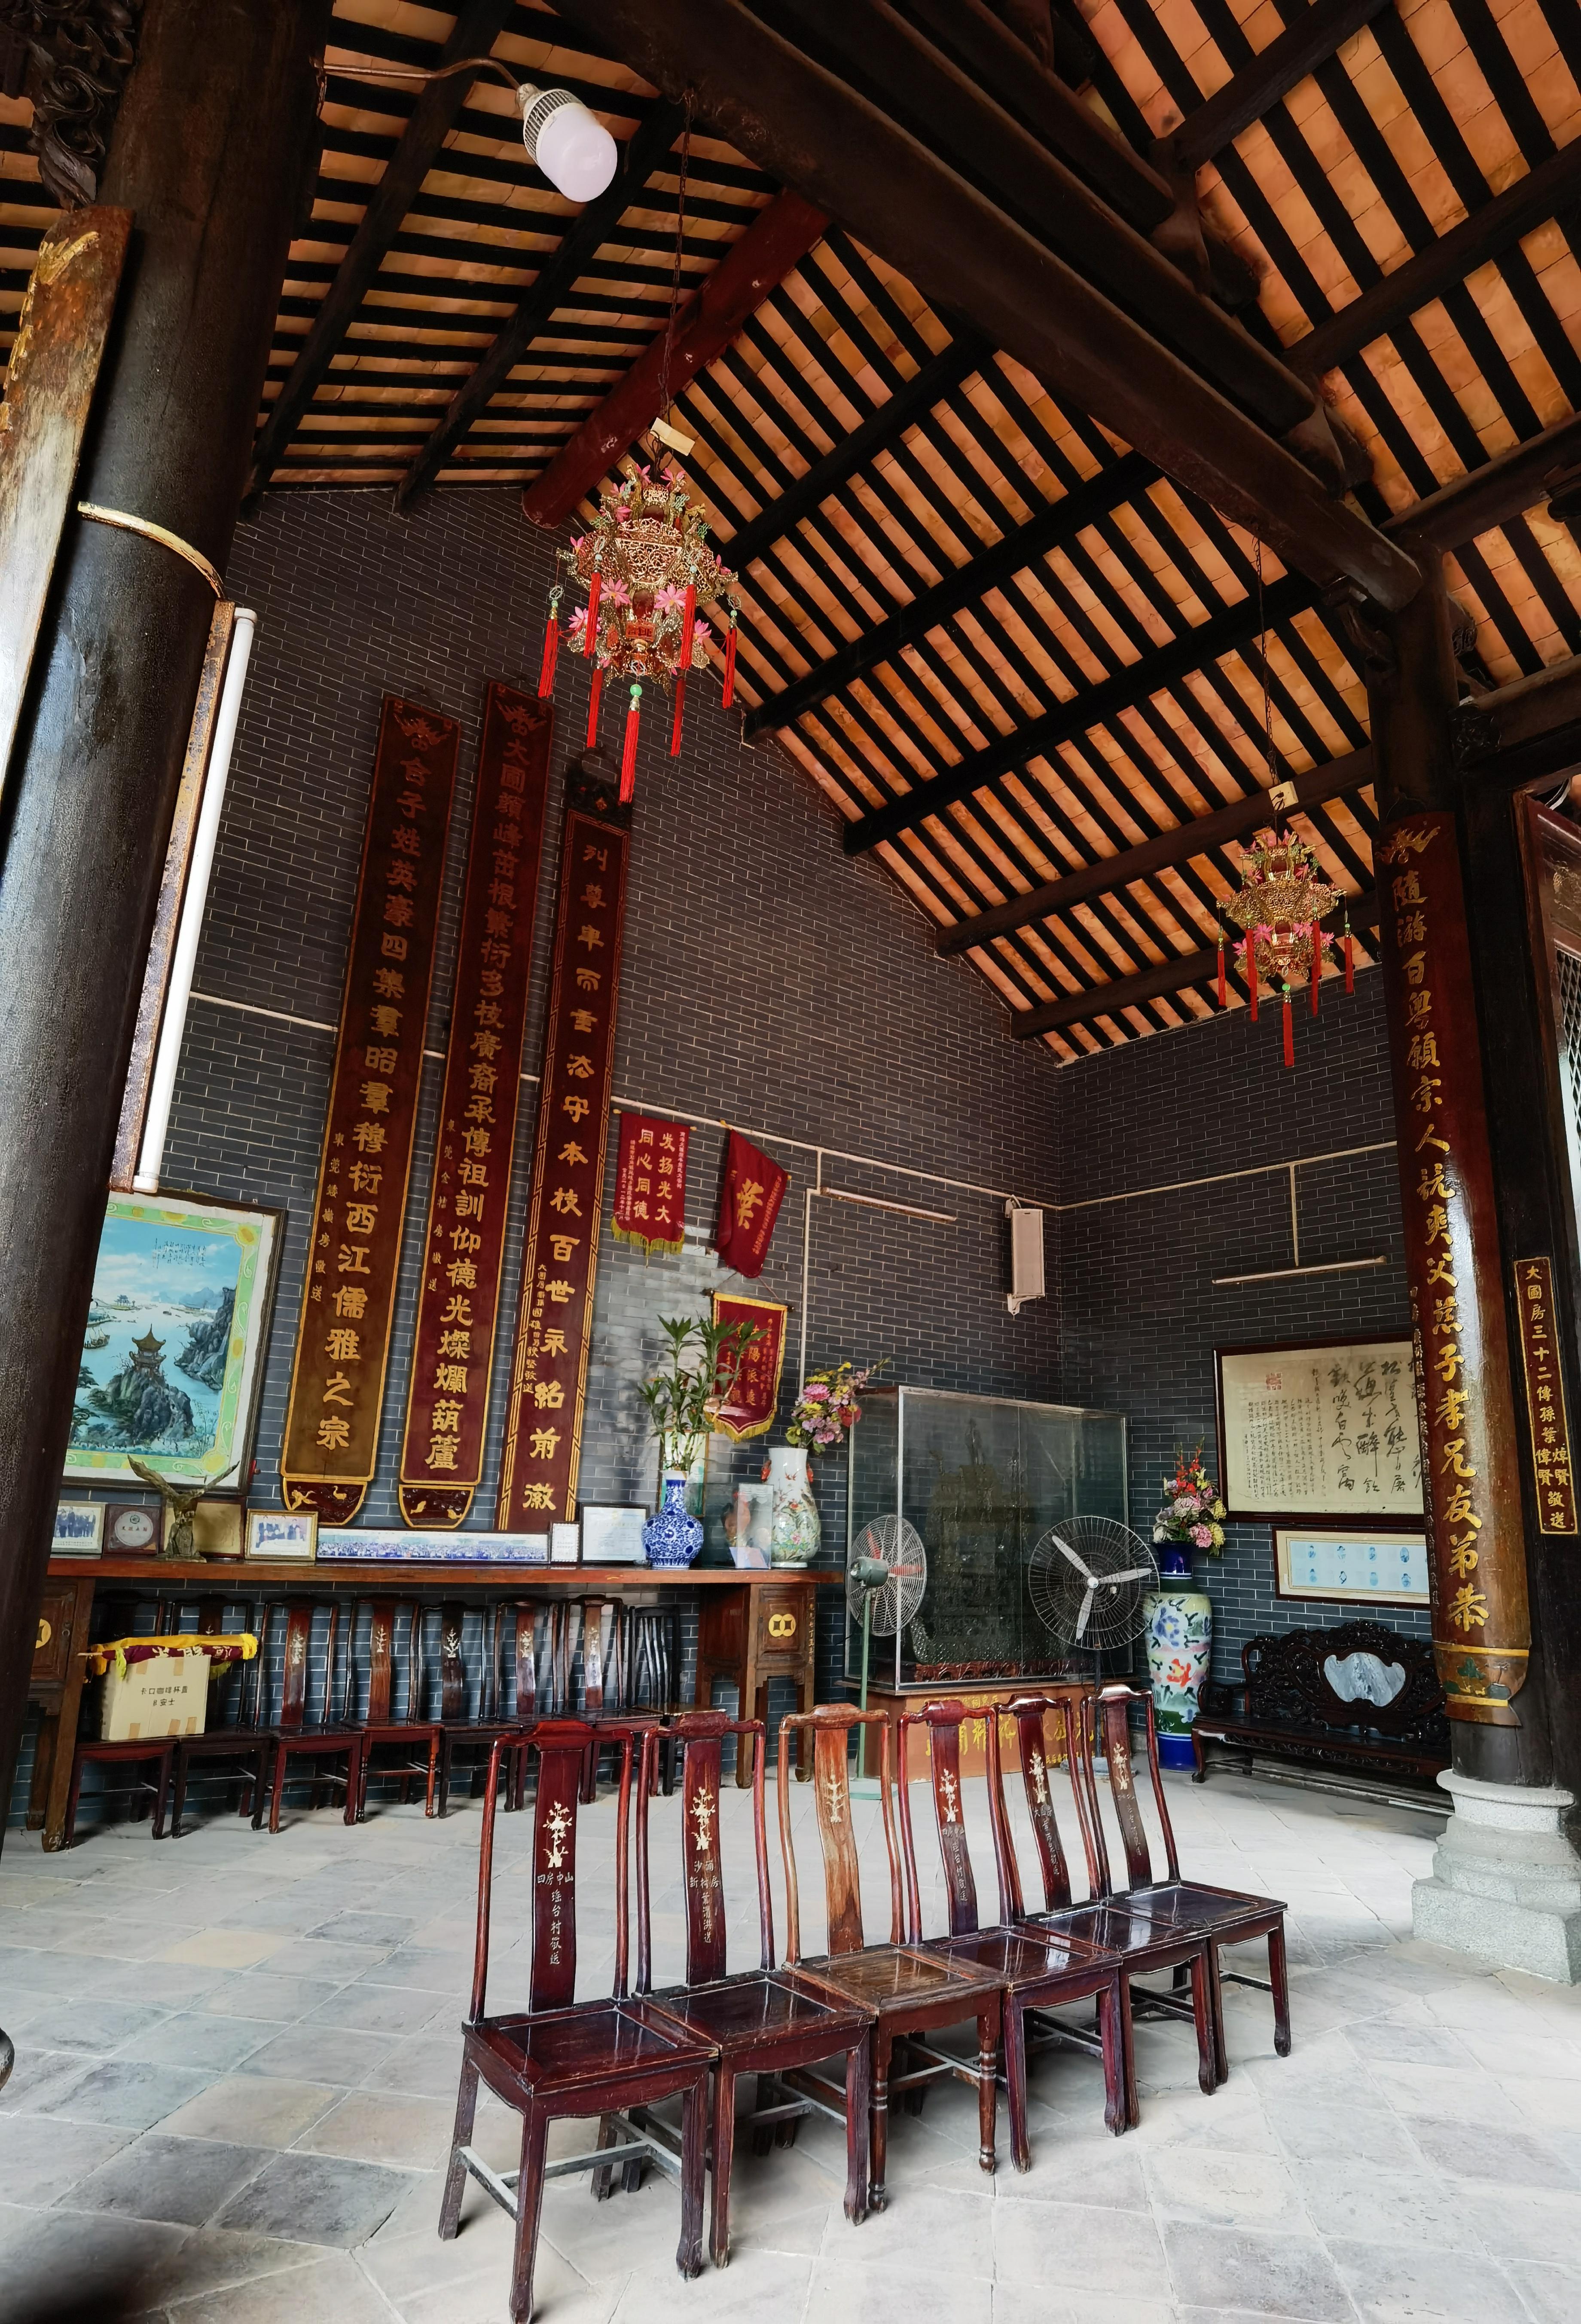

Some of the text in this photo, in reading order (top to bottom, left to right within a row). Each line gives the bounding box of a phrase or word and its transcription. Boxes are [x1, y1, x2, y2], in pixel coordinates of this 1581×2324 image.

[633, 1128, 653, 1220] 同心同德
[655, 1133, 675, 1223] 发扬光大
